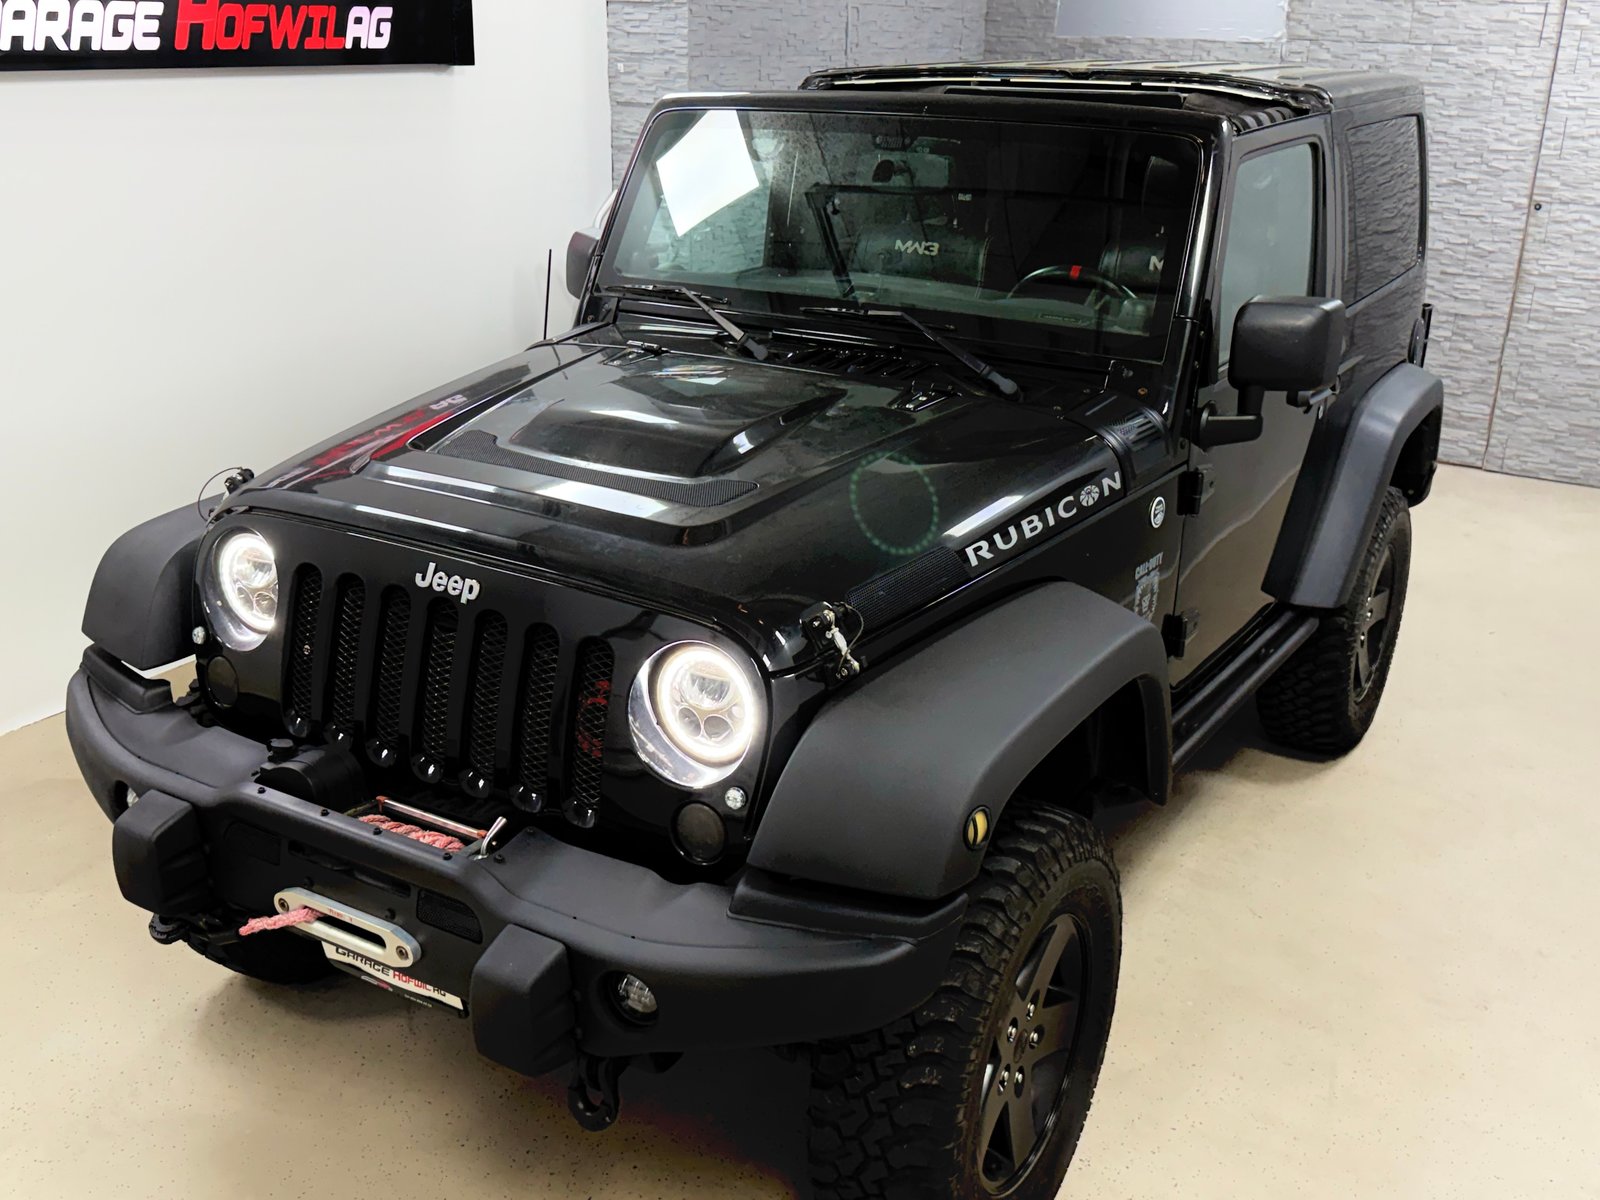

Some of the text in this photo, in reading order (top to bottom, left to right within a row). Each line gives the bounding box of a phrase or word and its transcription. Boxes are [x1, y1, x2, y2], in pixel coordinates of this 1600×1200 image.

[0, 0, 165, 51] ARAGE
[964, 471, 1122, 567] RUBICON
[414, 561, 480, 605] Jeep
